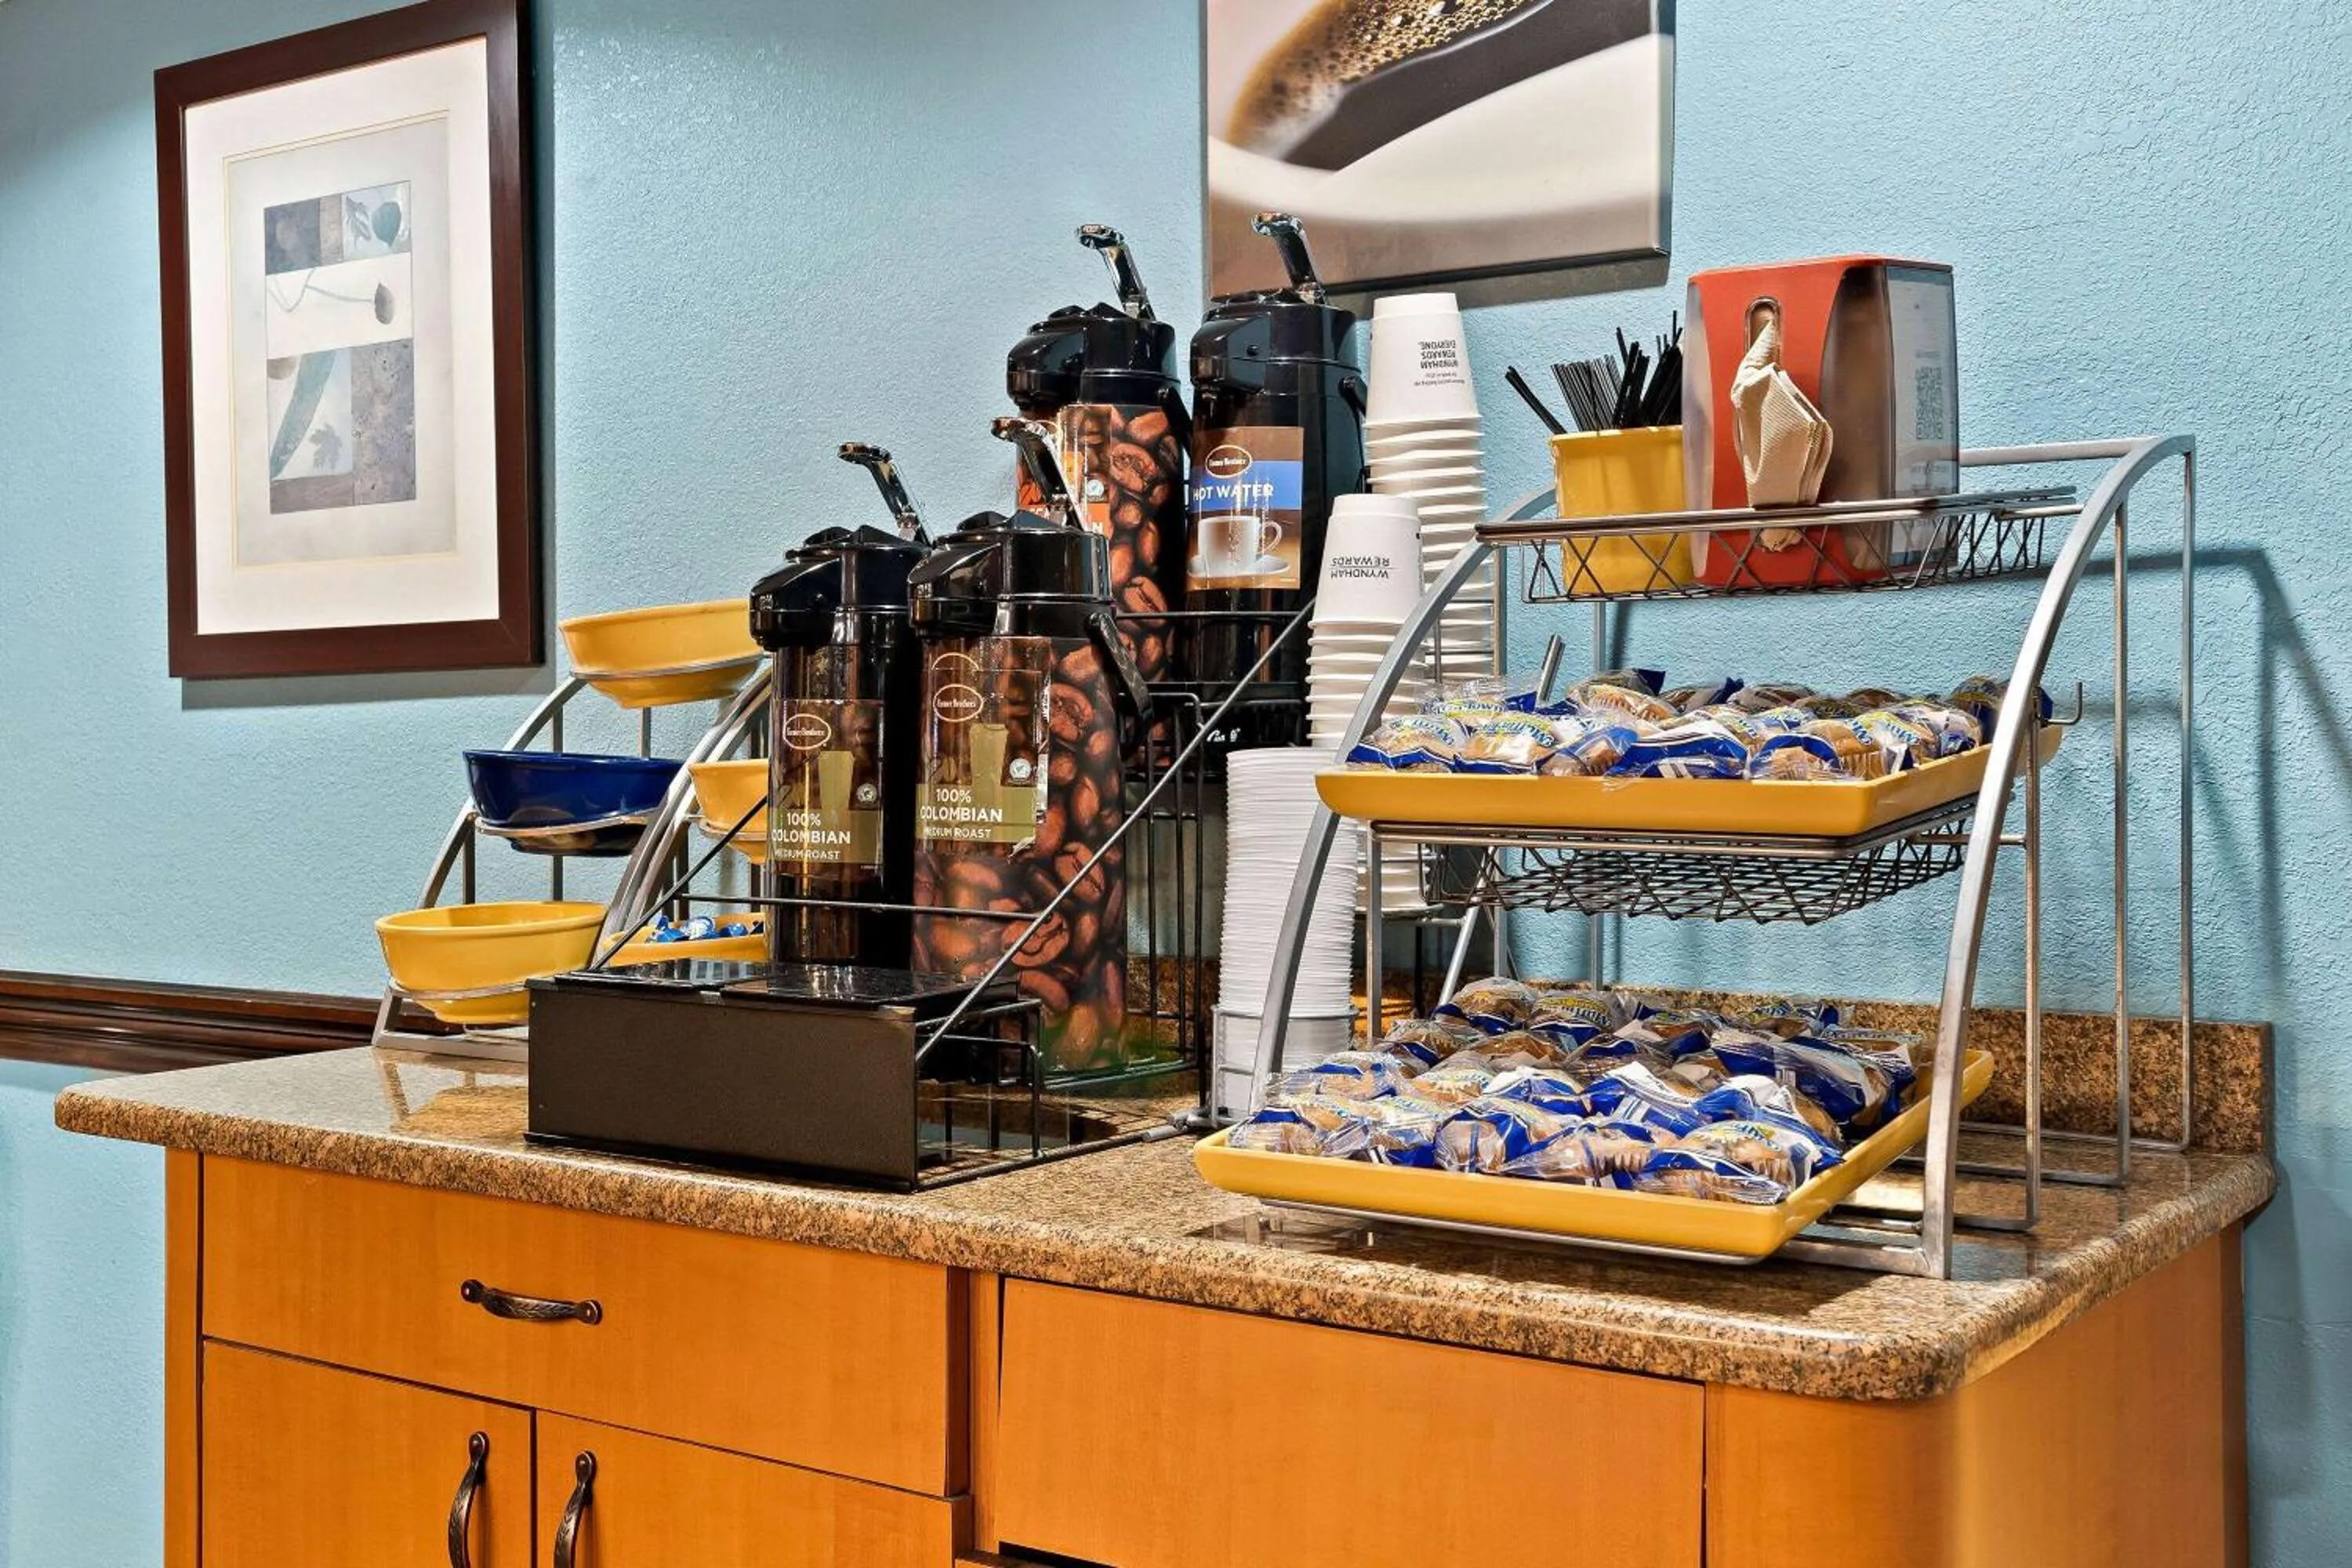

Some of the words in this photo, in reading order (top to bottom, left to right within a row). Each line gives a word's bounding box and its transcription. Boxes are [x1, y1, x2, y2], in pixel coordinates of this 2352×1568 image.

[1192, 486, 1214, 501] HOT
[1216, 483, 1275, 499] WATER
[1330, 556, 1390, 567] REWARDS
[1330, 568, 1389, 579] WYNDHAM
[935, 788, 972, 804] 100%
[786, 812, 822, 826] 100%
[920, 805, 1003, 822] COLOMBIAN
[771, 829, 851, 844] COLOMBIAN
[954, 828, 992, 838] ROAST
[804, 849, 841, 860] ROAST
